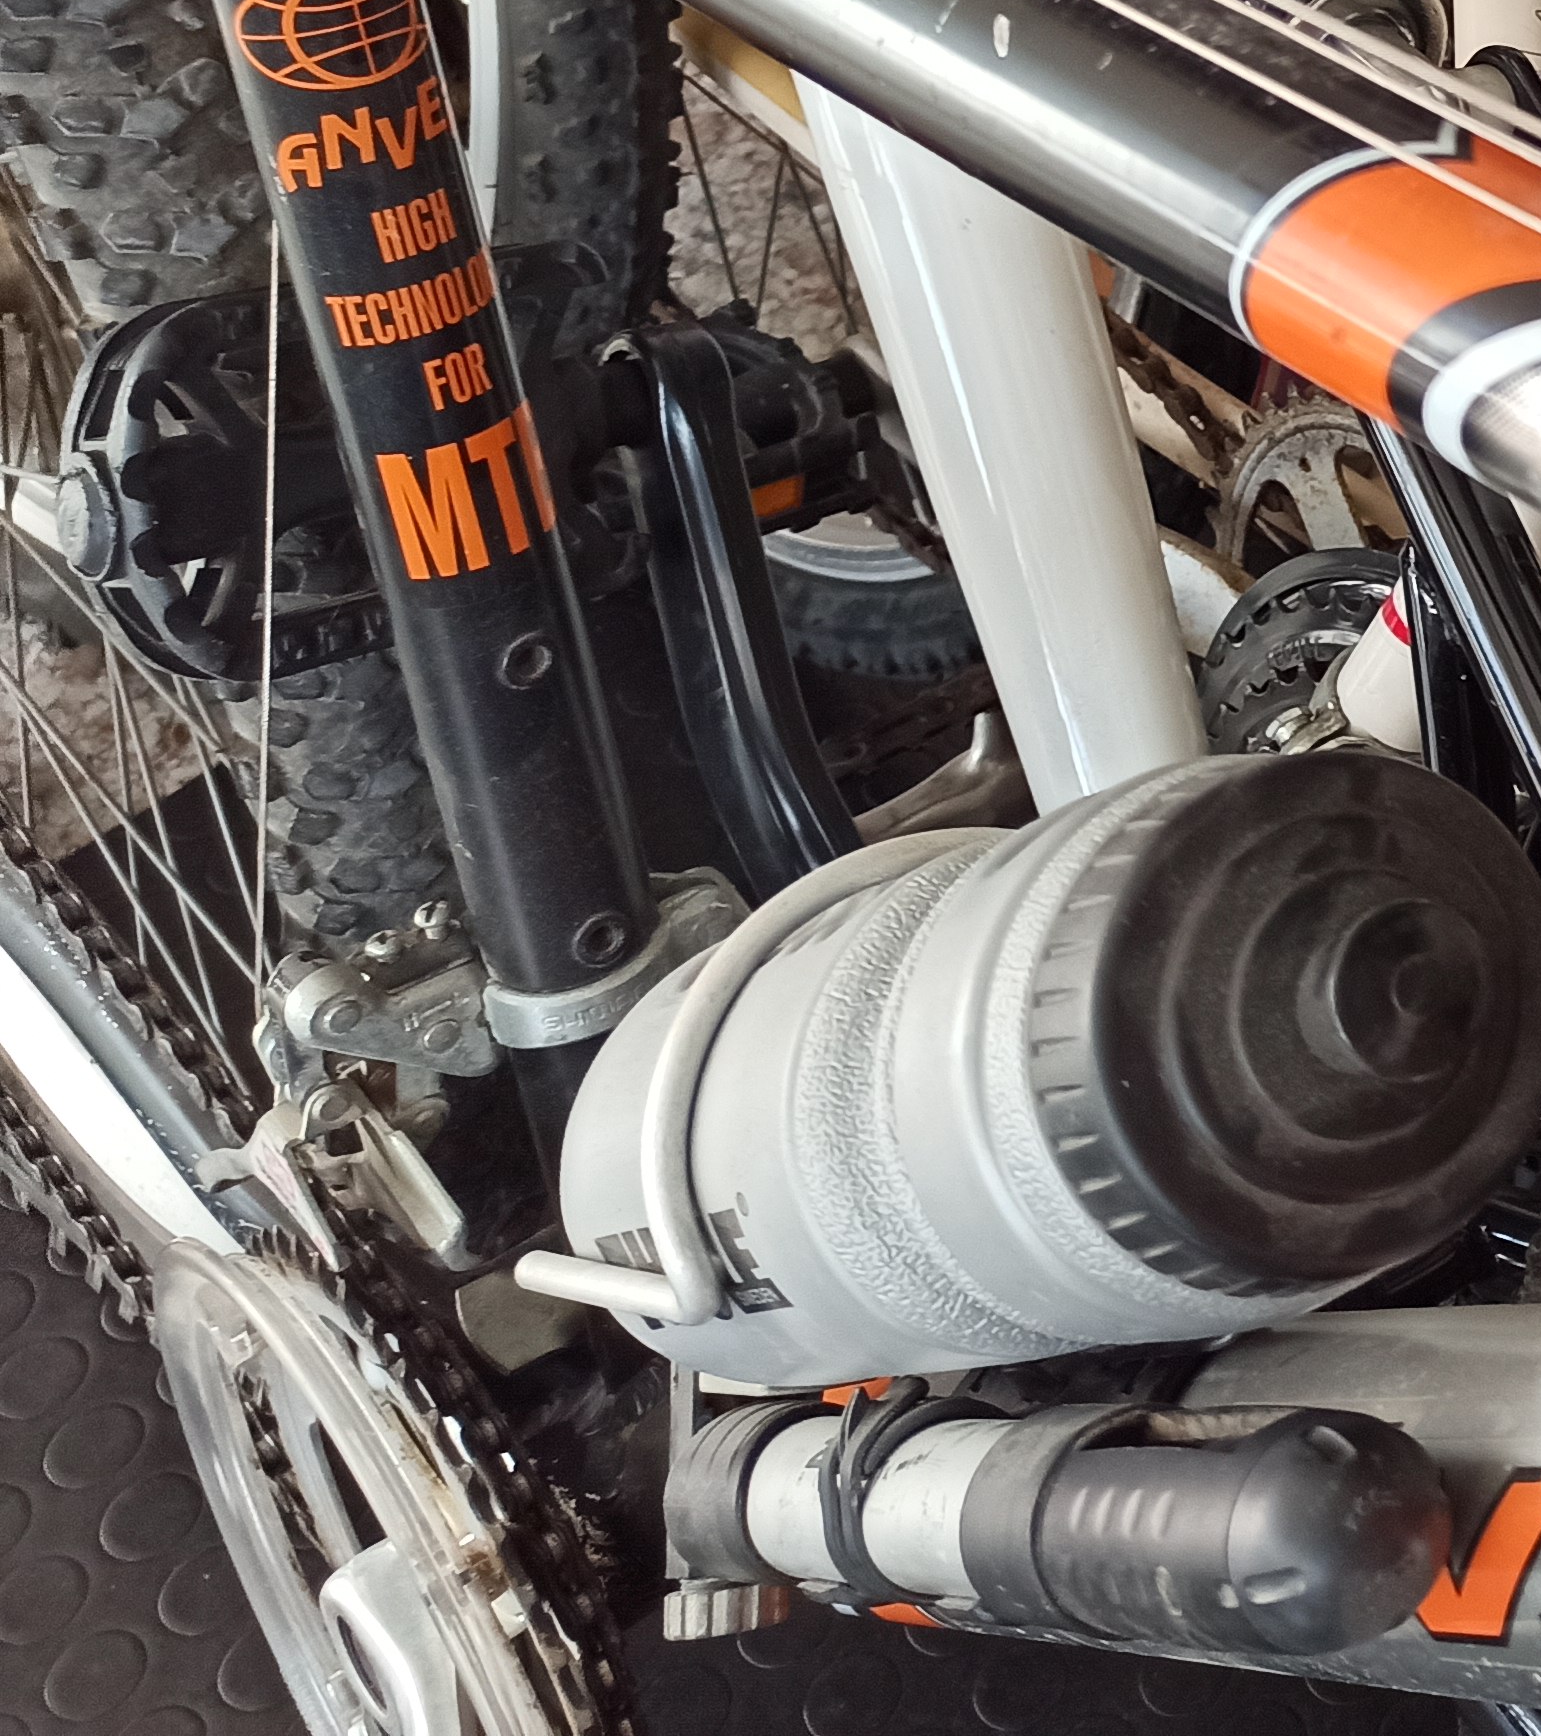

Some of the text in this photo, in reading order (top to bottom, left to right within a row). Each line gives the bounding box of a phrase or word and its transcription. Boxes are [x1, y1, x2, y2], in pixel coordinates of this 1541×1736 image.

[276, 75, 450, 194] ANVE
[370, 188, 458, 264] HIGH
[324, 246, 497, 348] TECHNOLO
[422, 342, 494, 412] FOR
